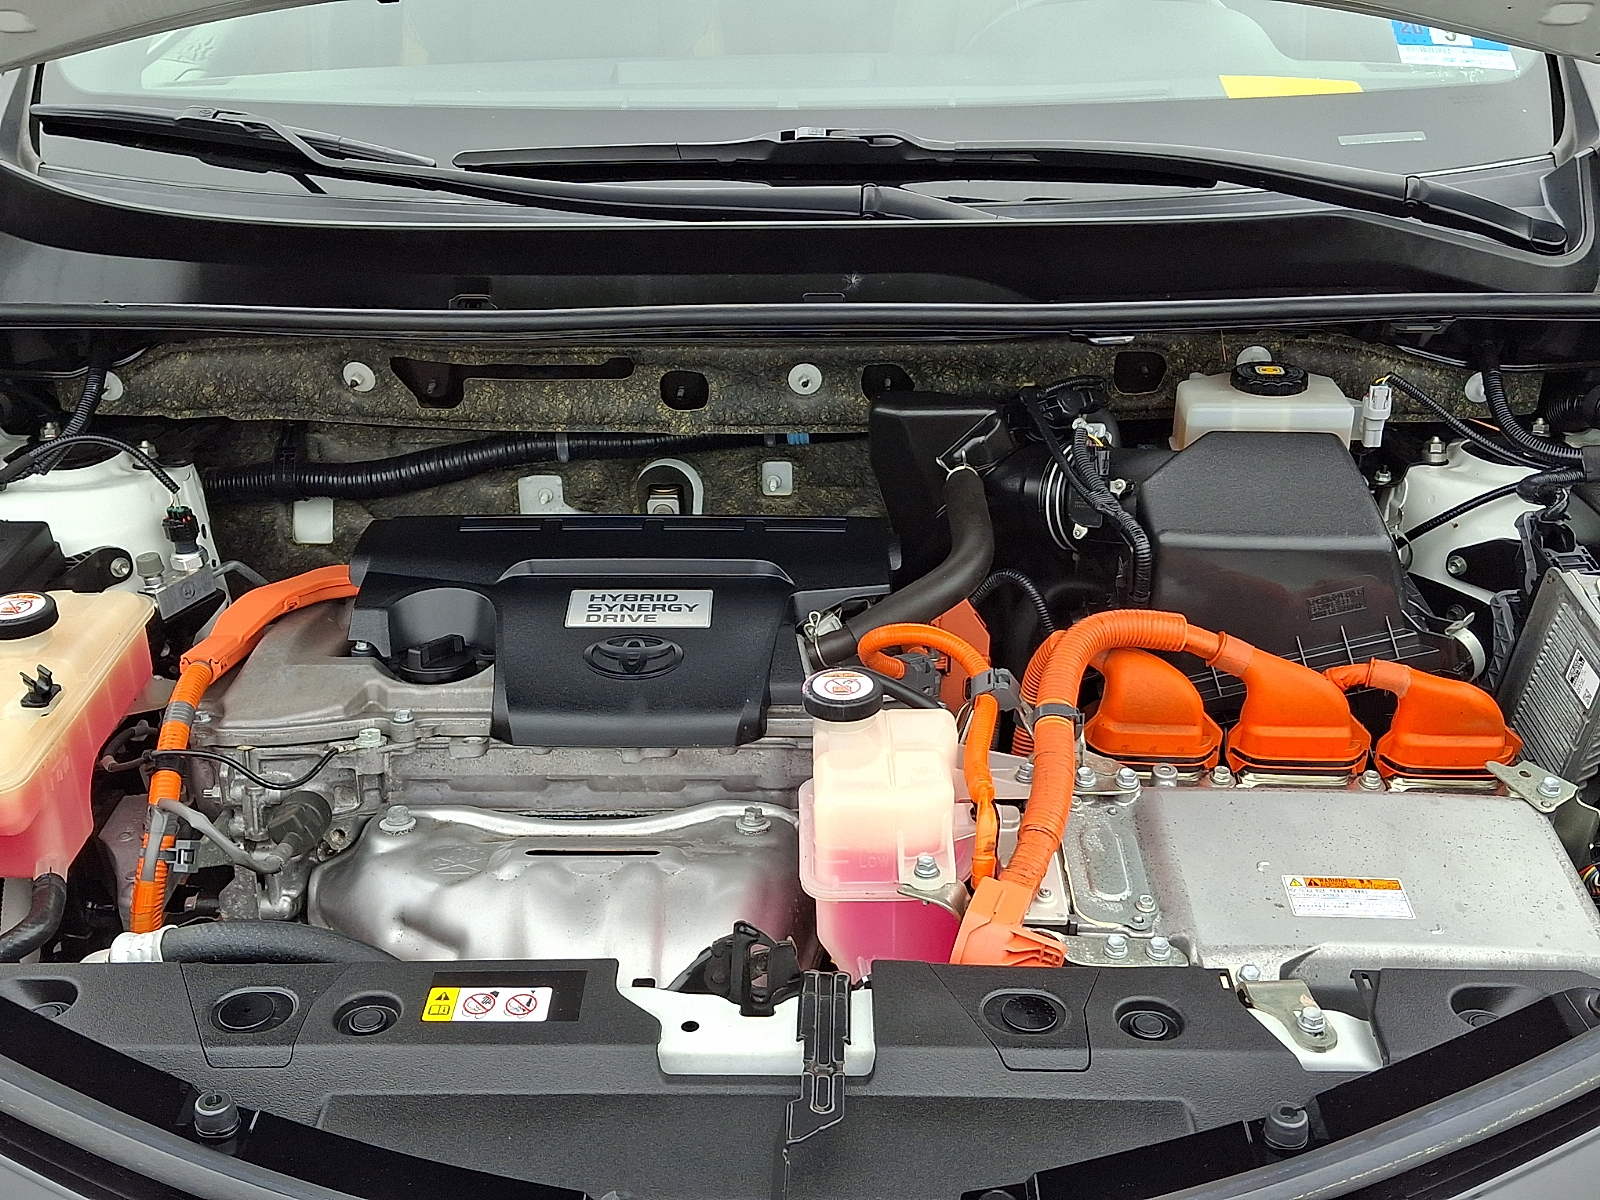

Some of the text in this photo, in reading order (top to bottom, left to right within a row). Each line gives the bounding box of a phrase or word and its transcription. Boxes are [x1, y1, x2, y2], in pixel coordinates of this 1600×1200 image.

[589, 593, 679, 602] HYBRID
[587, 603, 700, 613] SYNERGY
[585, 613, 658, 623] DRIVE
[859, 855, 890, 868] LOW
